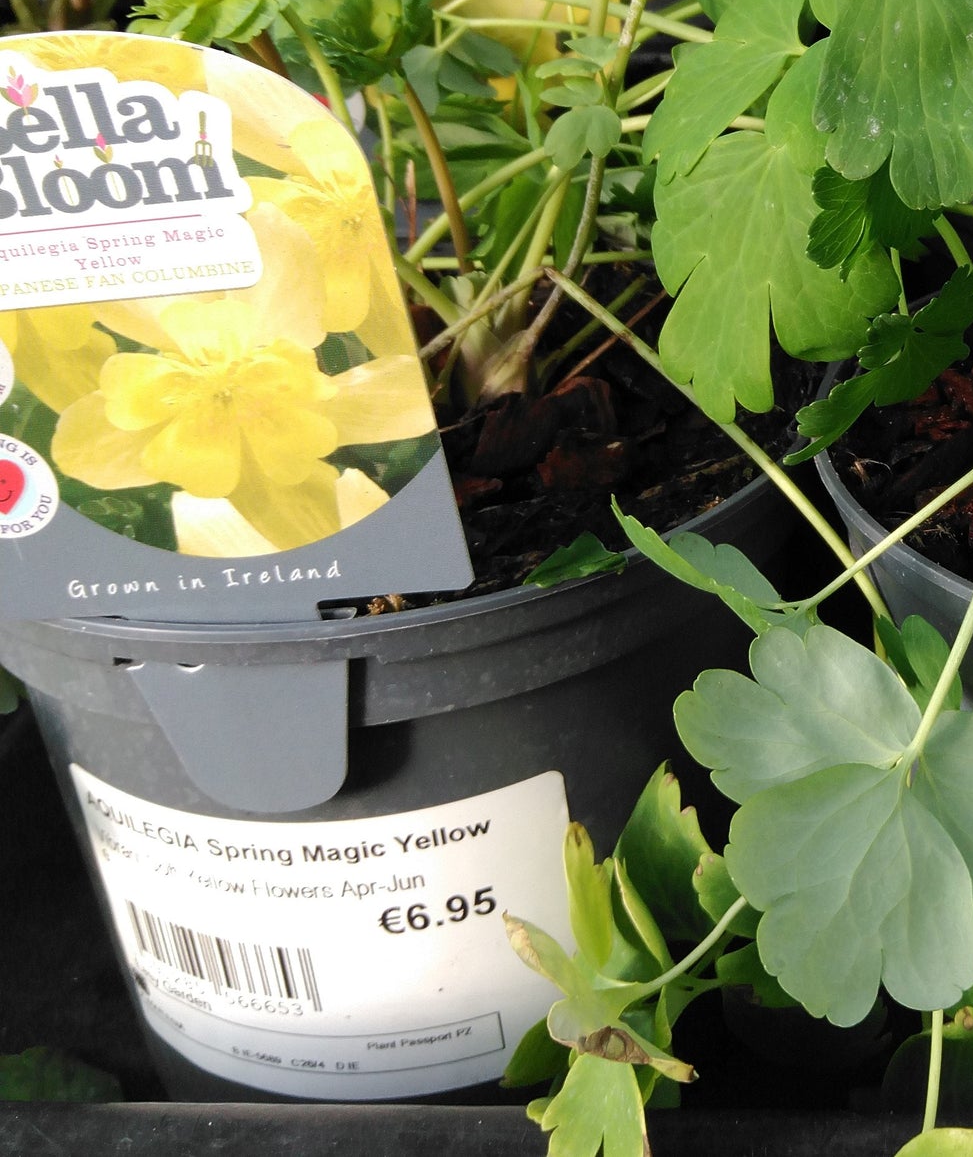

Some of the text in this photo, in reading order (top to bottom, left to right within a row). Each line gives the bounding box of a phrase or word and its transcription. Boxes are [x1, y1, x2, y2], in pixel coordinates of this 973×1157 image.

[0, 82, 181, 155] ella
[0, 155, 234, 219] loom
[0, 227, 225, 261] quilegia Spring Magic
[75, 255, 141, 270] Yellow
[85, 273, 127, 288] FAN
[132, 261, 256, 283] COLUMBINE
[20, 452, 37, 466] IS
[32, 495, 52, 521] YOU
[68, 560, 341, 599] Grown in Ireland
[87, 791, 199, 852] AQUILEGIA
[207, 838, 293, 866] Spring
[302, 841, 386, 864] Magic
[394, 819, 492, 854] Yellow
[252, 878, 334, 899] Flowers
[341, 874, 426, 900] Apr-Jun
[378, 886, 497, 934] €6.95
